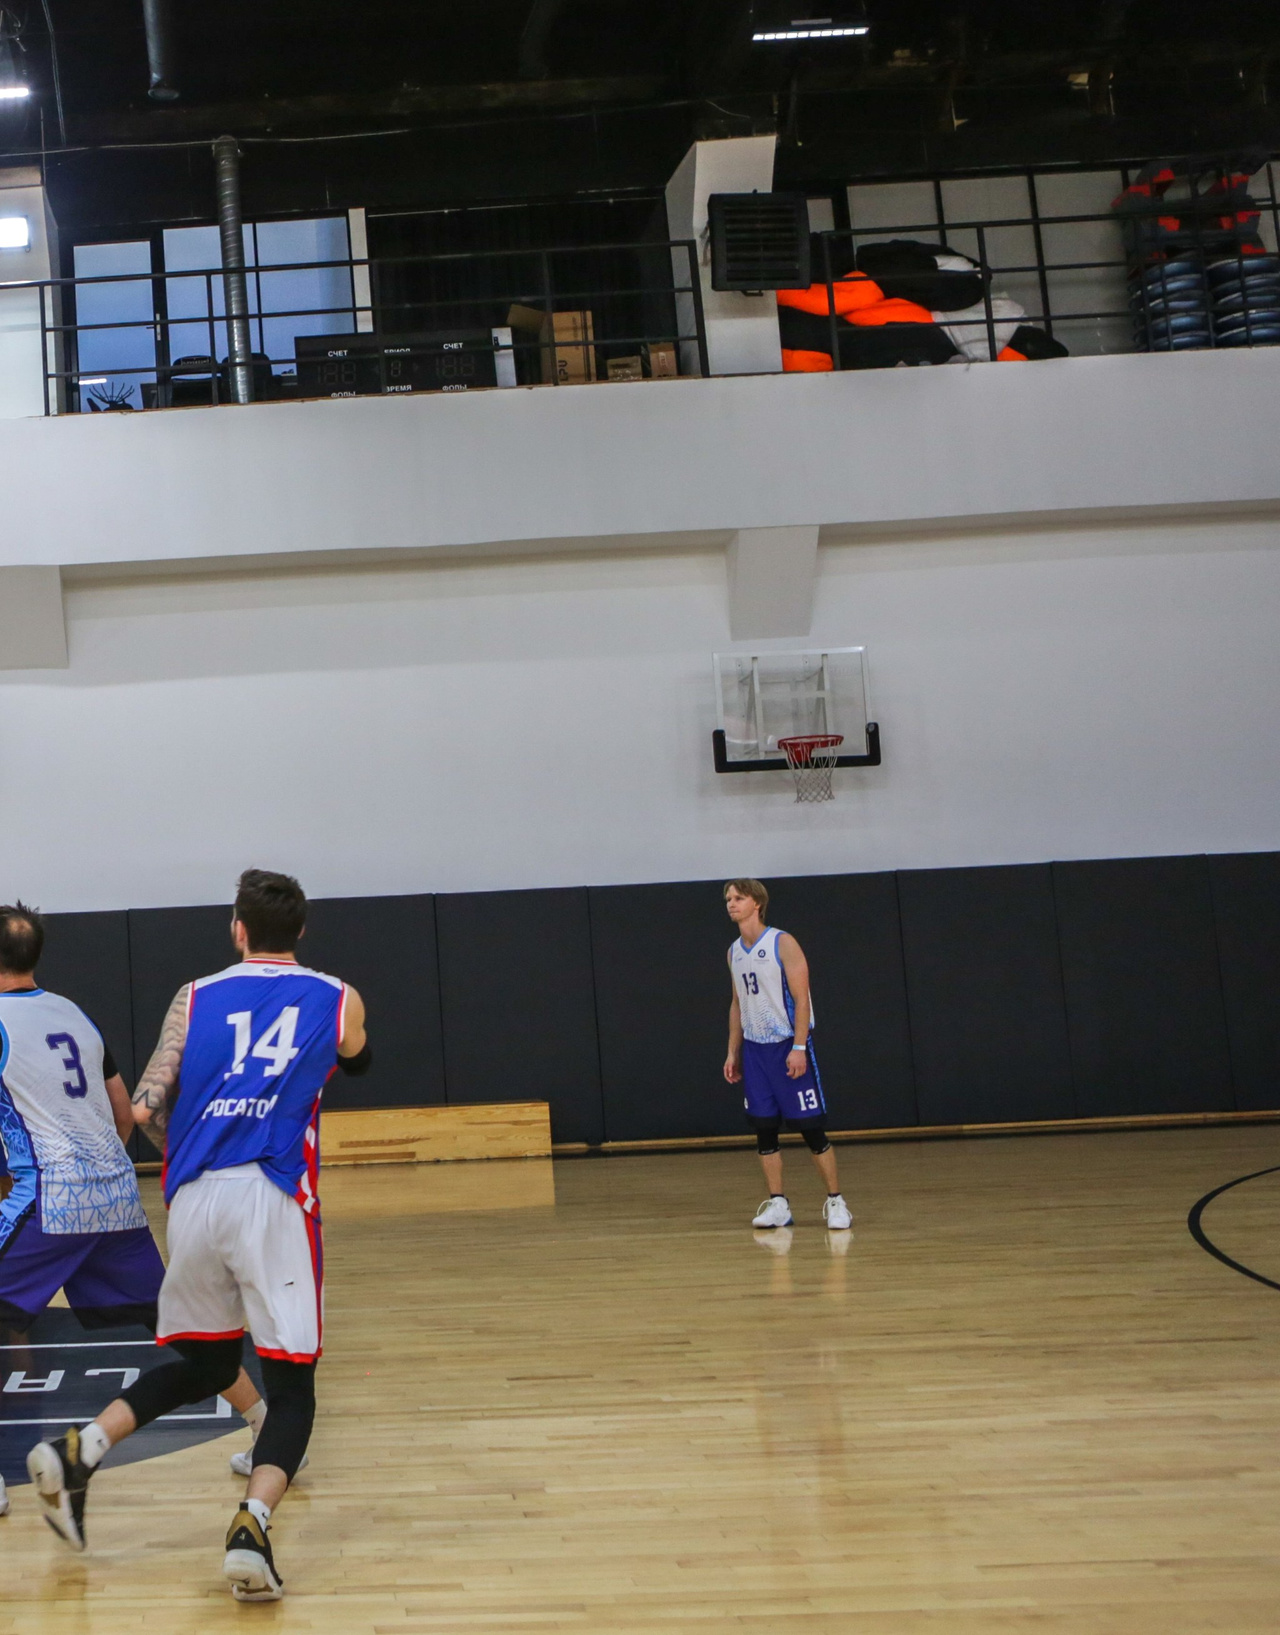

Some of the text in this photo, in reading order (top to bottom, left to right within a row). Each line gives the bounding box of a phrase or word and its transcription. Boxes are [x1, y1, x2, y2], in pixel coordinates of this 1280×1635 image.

[328, 350, 348, 358] СЧЕТ
[443, 342, 463, 350] СЧЕТ
[742, 972, 759, 995] 13
[224, 1005, 300, 1081] 14
[45, 1032, 88, 1099] 3
[797, 1088, 818, 1112] 13
